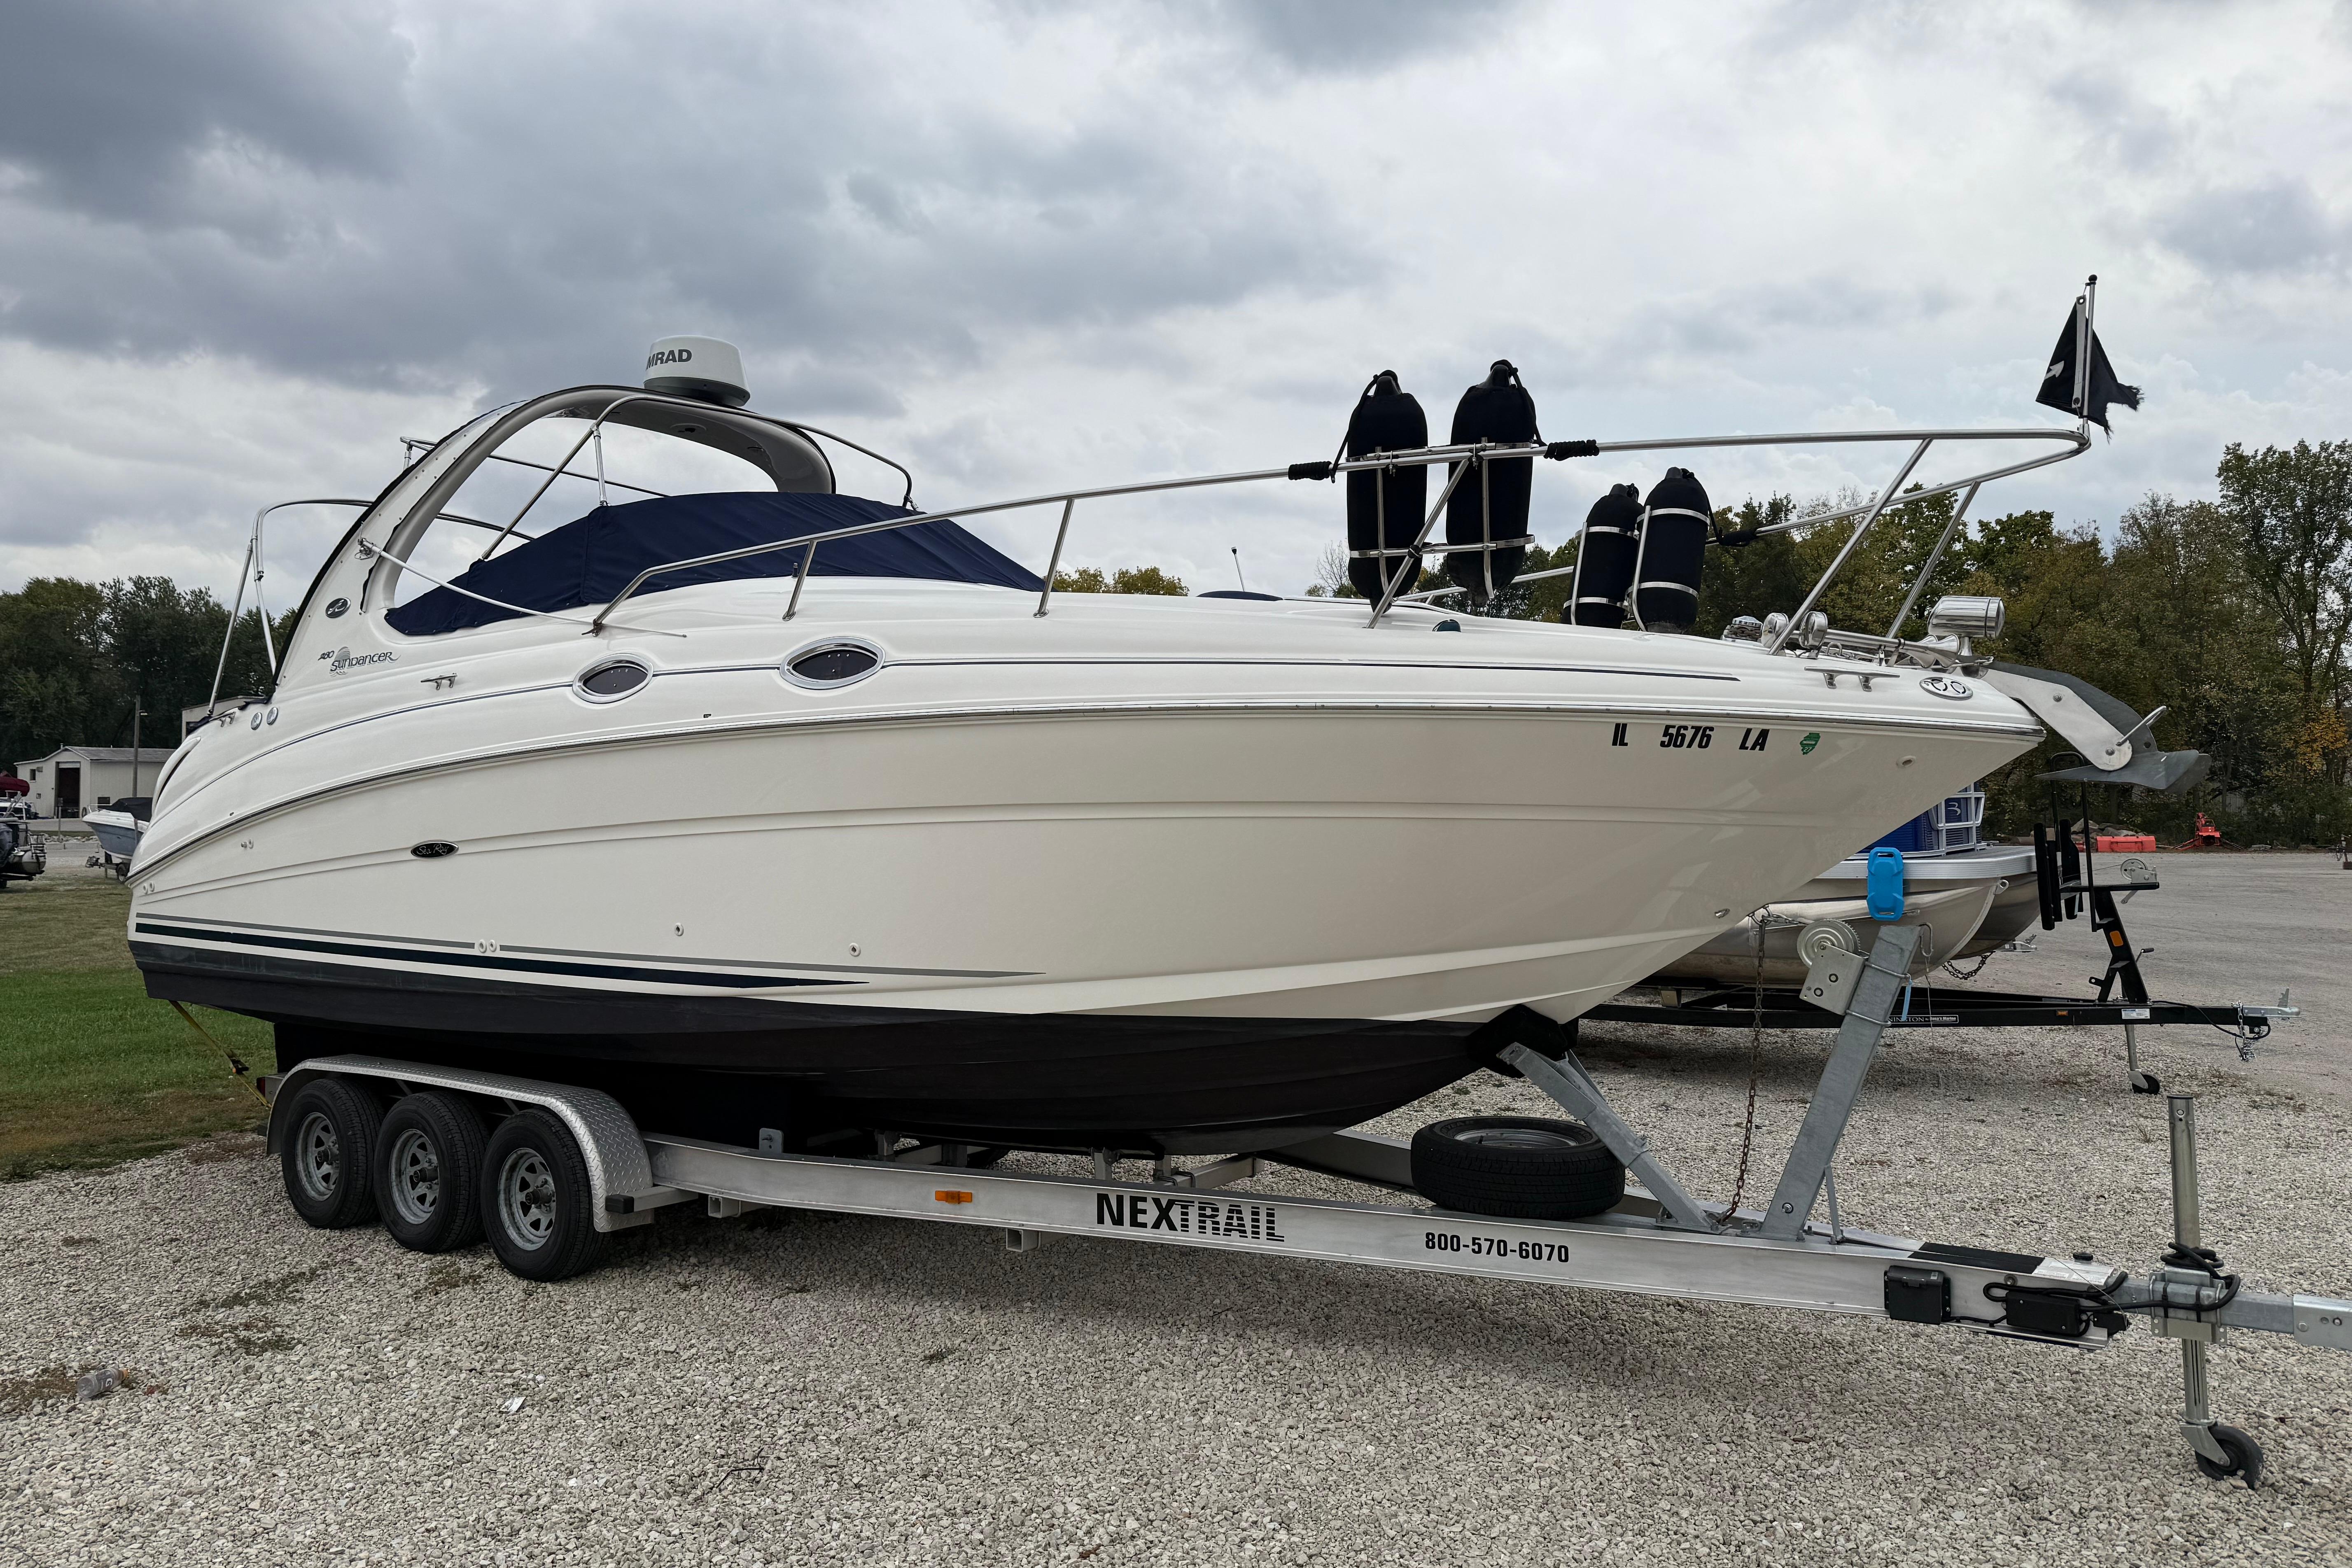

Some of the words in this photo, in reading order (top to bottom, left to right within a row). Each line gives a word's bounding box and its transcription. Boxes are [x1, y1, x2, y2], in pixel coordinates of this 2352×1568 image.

[1612, 723, 1629, 746] IL
[1660, 725, 1715, 749] 5676
[1738, 728, 1770, 751] LA
[416, 846, 432, 855] Sea
[433, 843, 450, 855] Ray
[1097, 1193, 1285, 1242] NEXTRAIL
[1425, 1232, 1569, 1263] 800-570-6070
